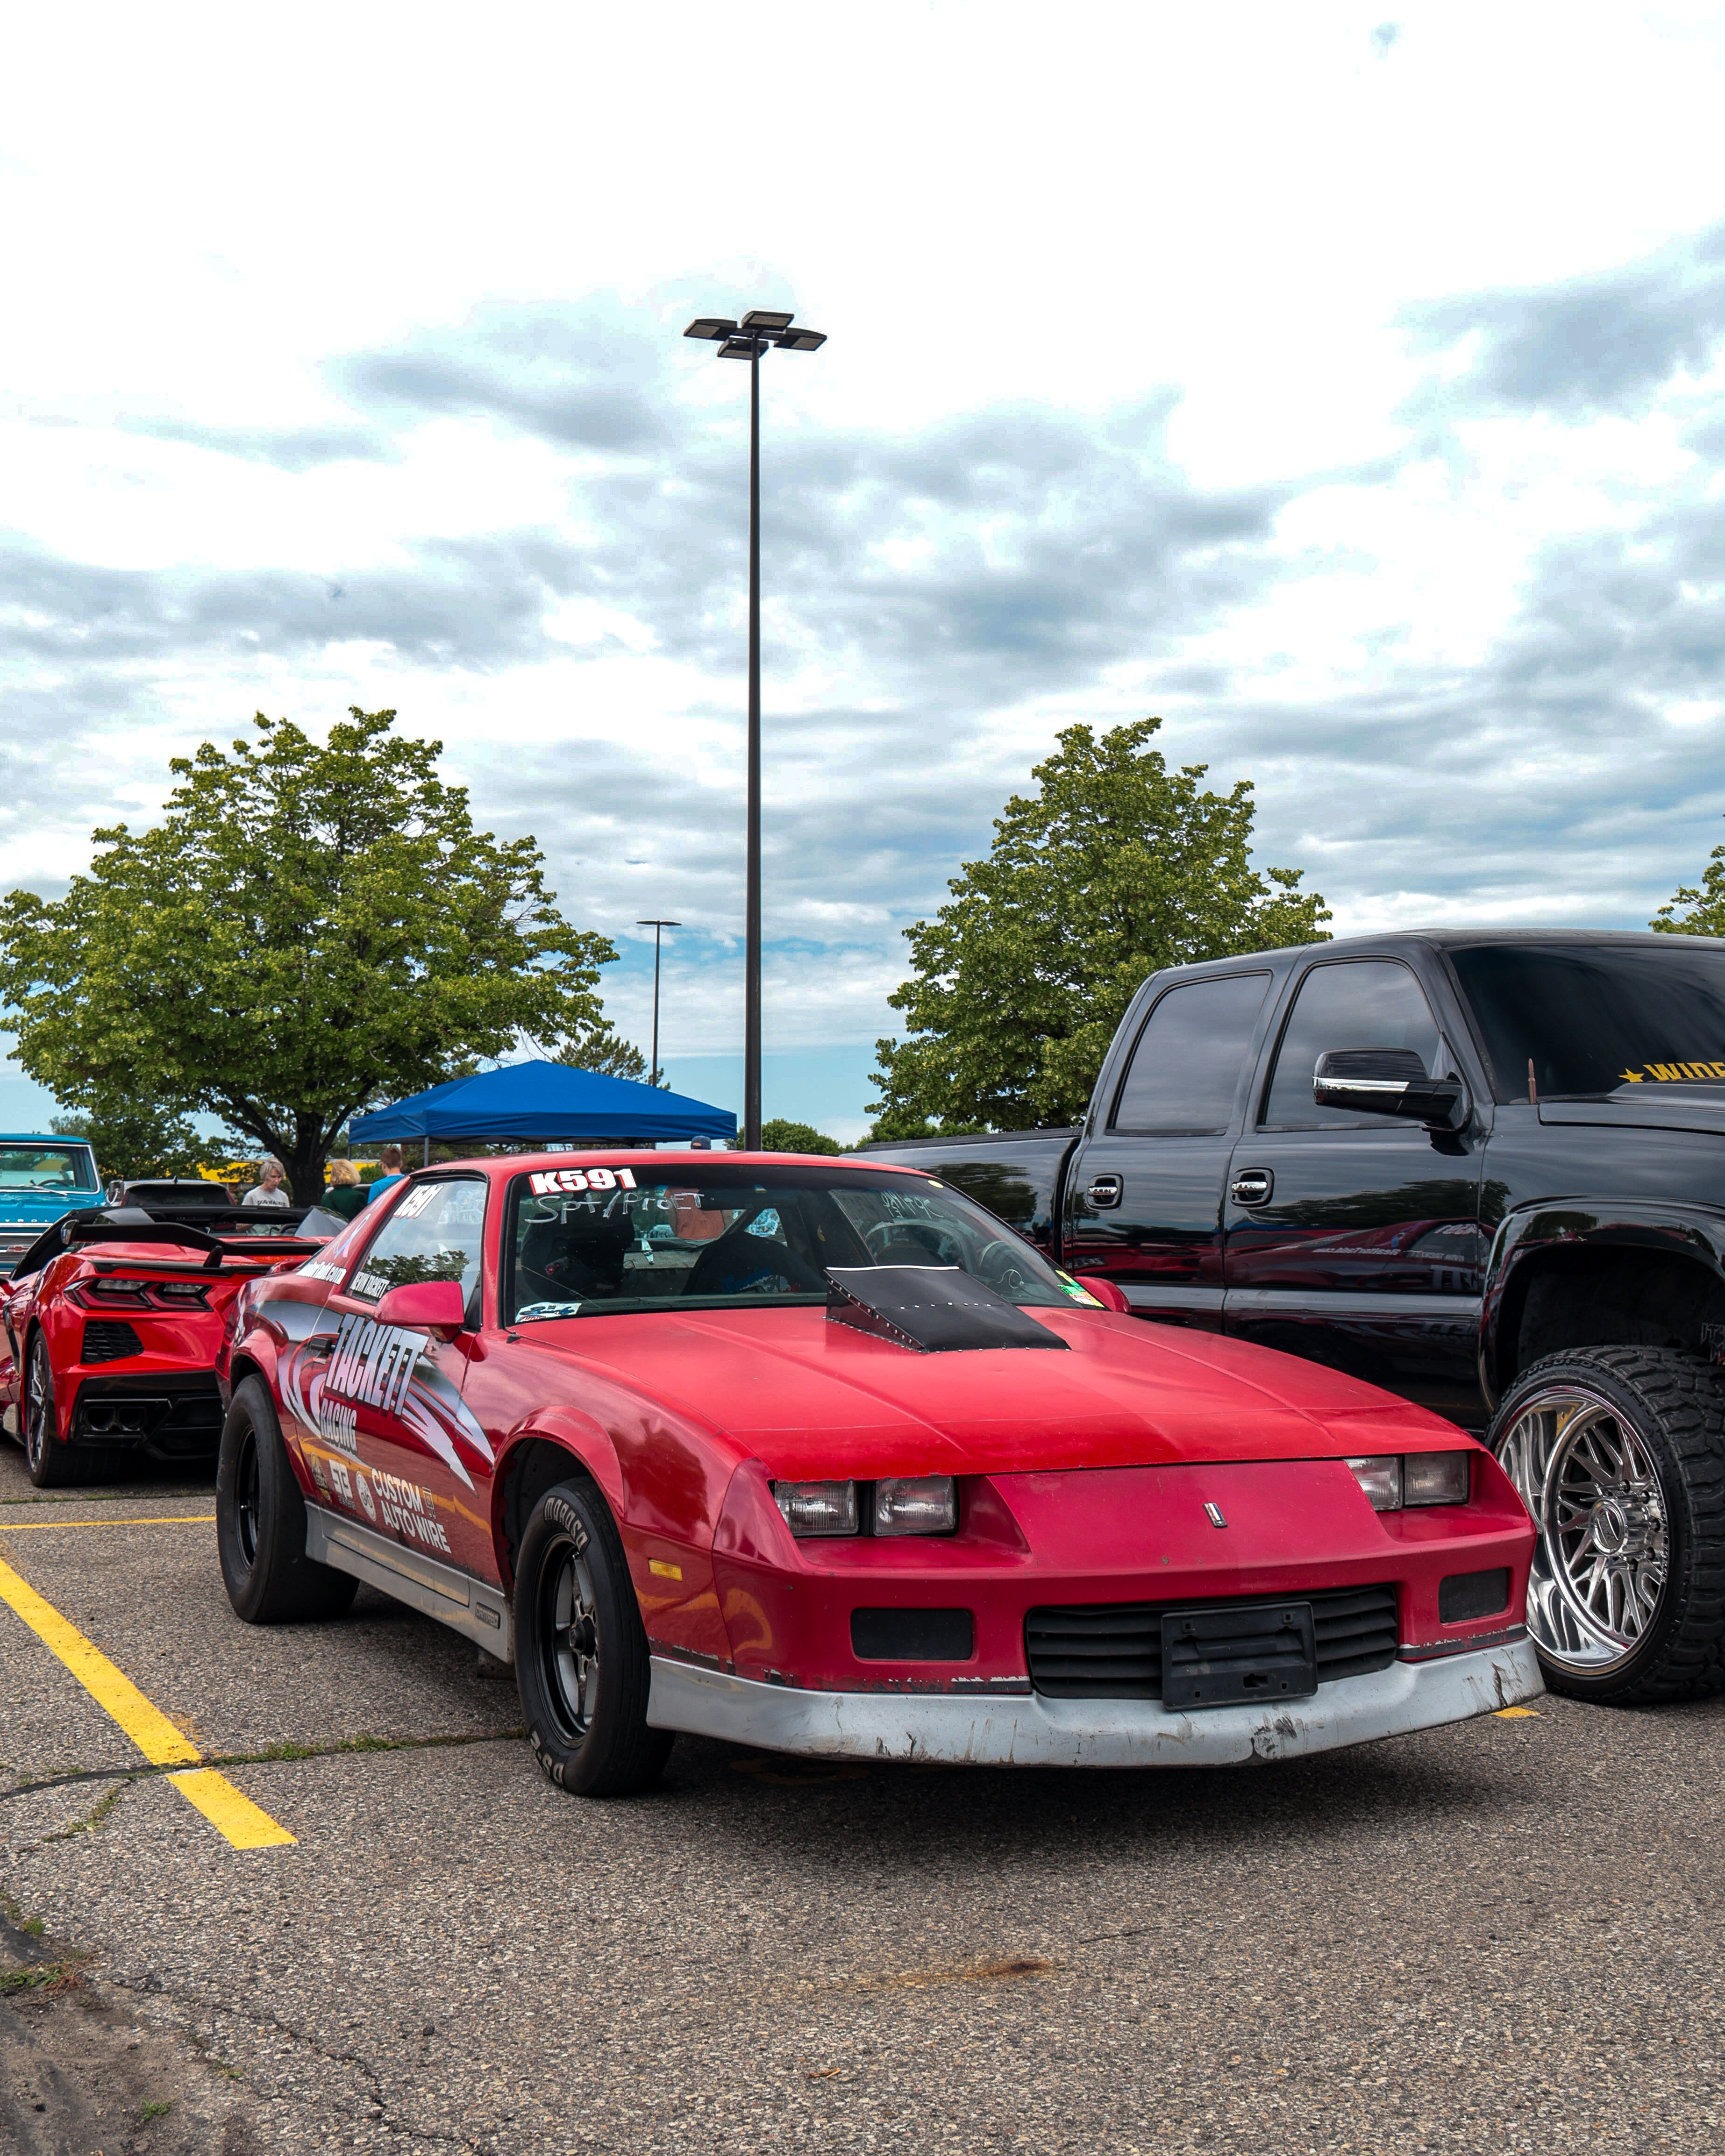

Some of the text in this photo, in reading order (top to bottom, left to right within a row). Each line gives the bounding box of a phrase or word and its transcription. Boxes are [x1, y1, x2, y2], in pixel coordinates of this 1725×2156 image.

[529, 1168, 637, 1195] K591
[325, 1312, 430, 1416] TACKETT
[320, 1397, 357, 1452] RACING
[371, 1468, 425, 1515] CUSTOM
[544, 1497, 588, 1551] MOROSO
